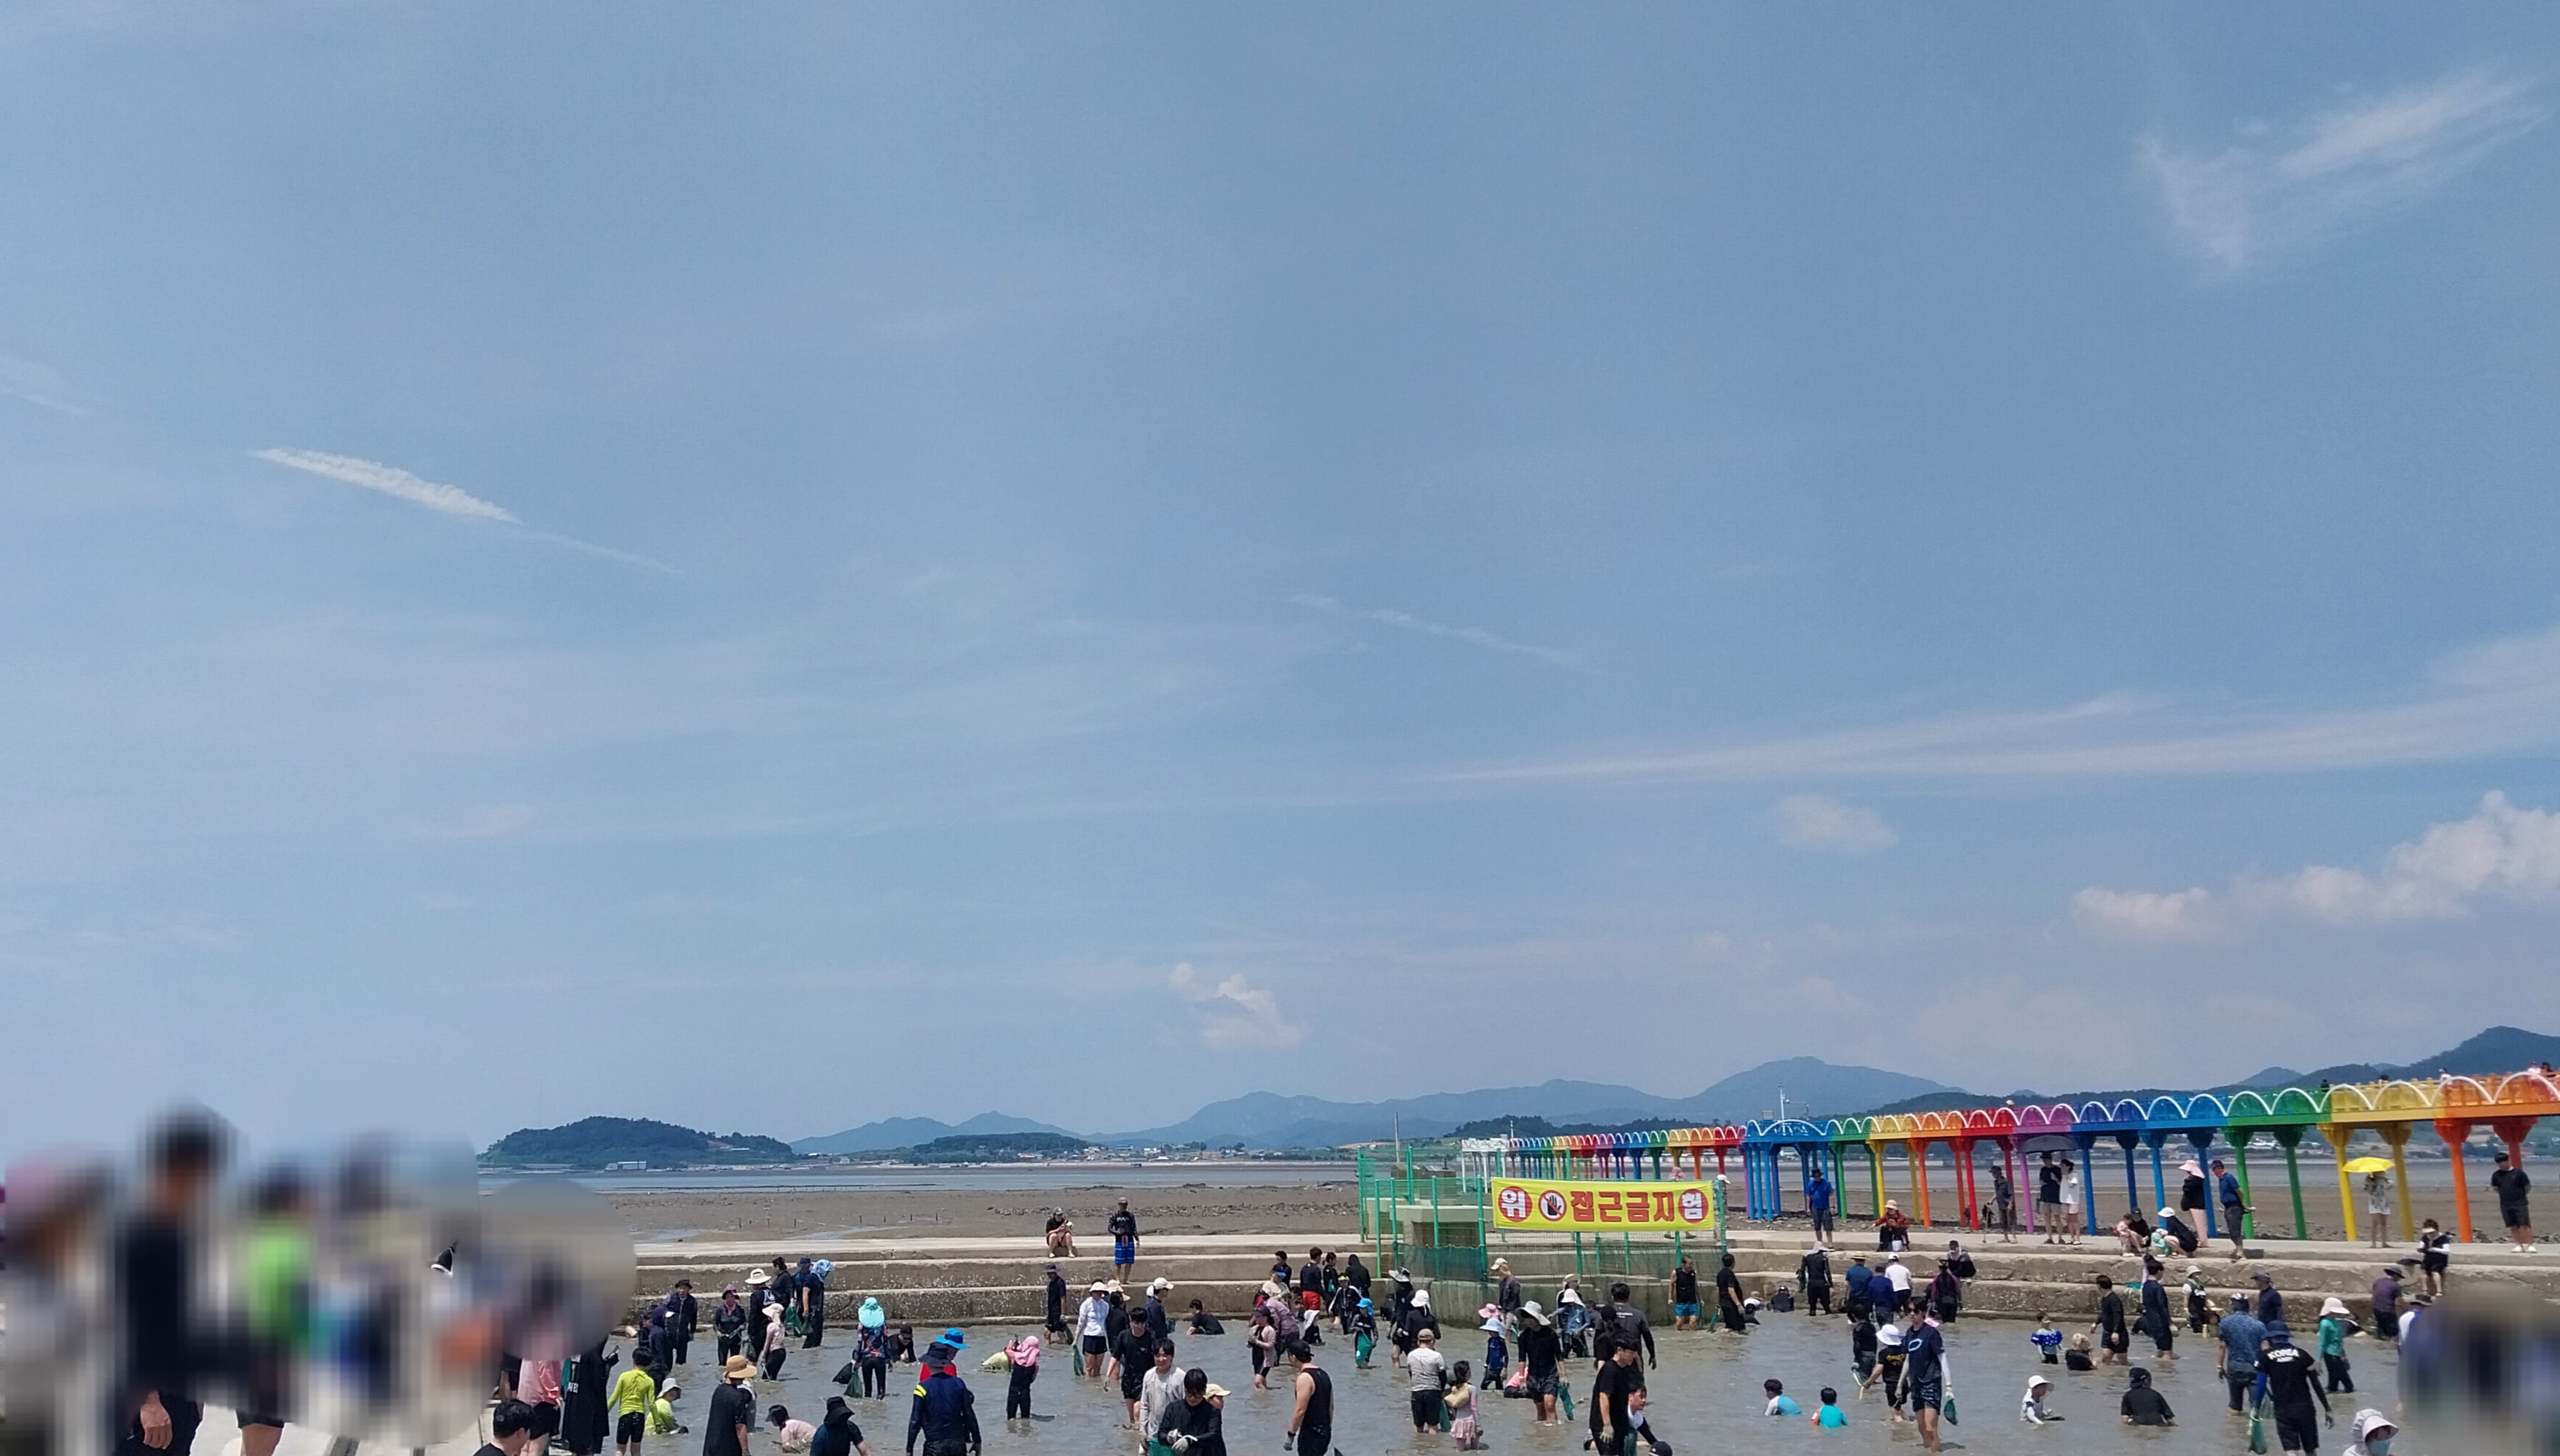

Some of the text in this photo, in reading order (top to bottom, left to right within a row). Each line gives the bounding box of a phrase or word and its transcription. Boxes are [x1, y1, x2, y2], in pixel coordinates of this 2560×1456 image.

[1502, 1190, 1703, 1222] 위 접근금지 험
[2267, 1349, 2300, 1360] KOREA
